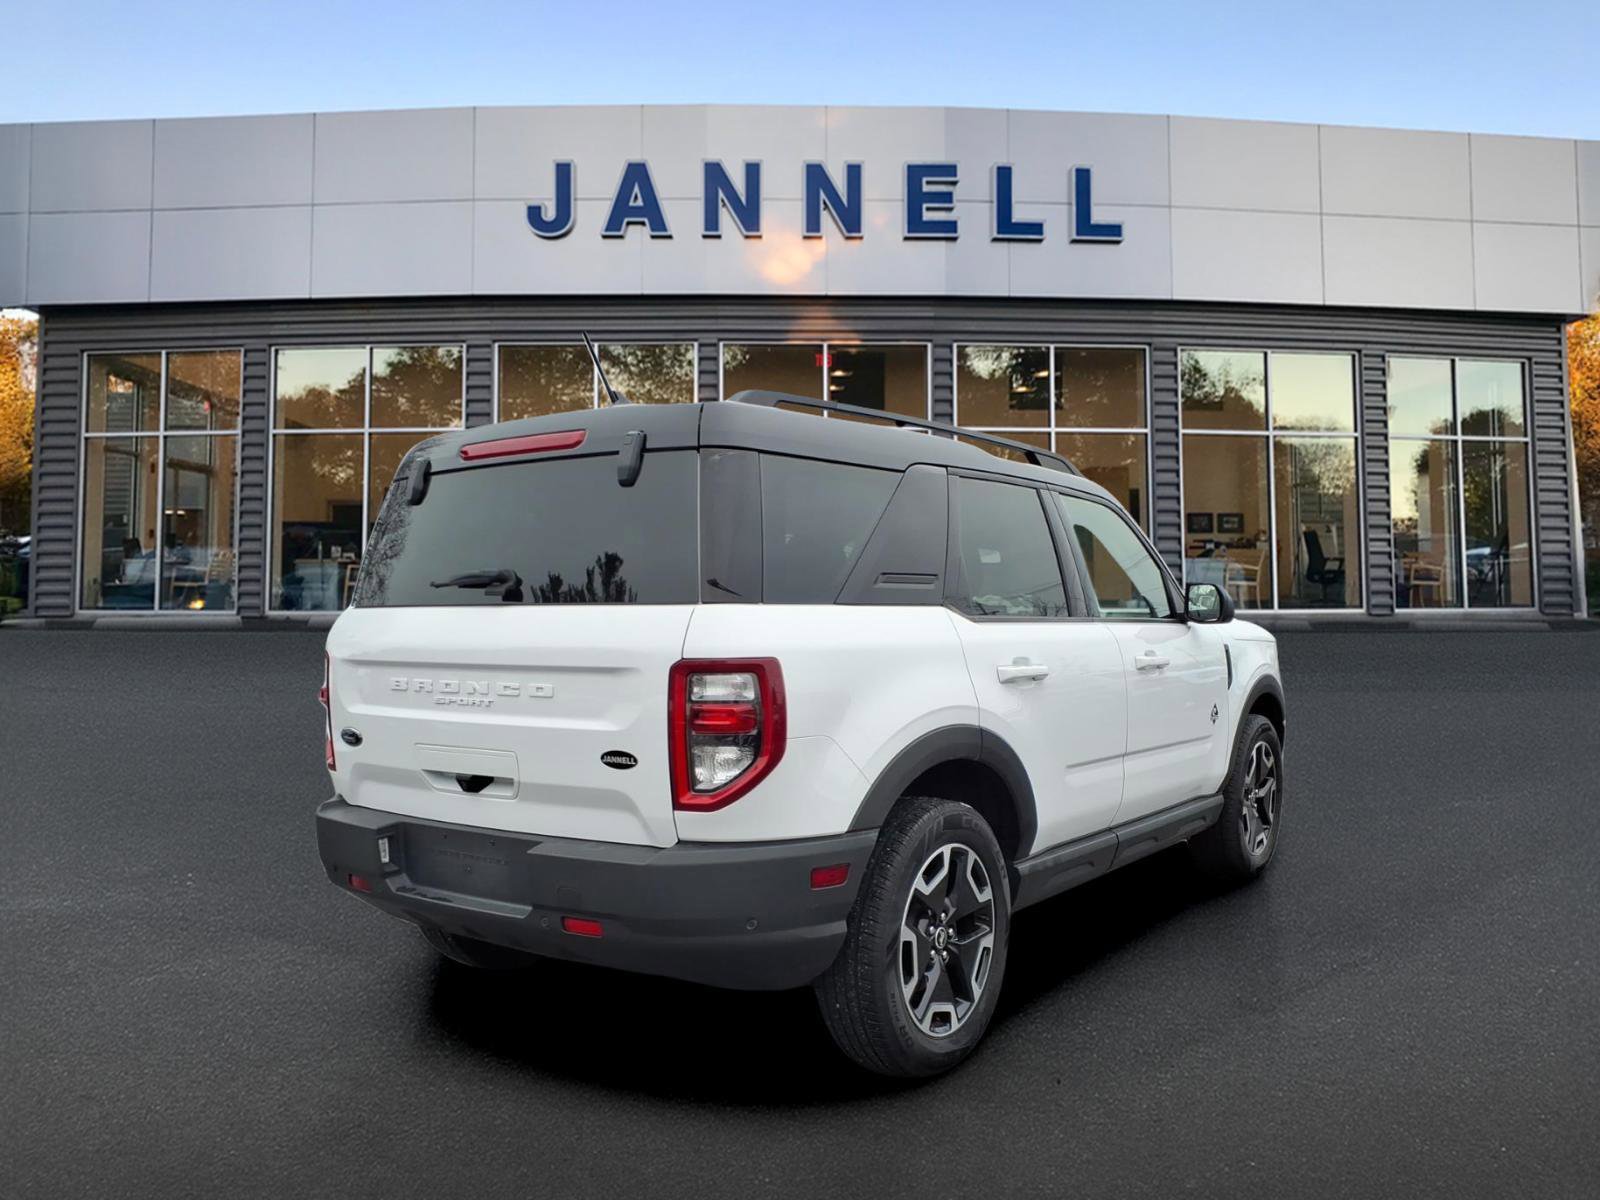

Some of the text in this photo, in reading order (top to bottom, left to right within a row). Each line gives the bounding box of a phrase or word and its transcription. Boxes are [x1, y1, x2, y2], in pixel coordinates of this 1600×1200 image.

[525, 159, 1124, 243] JANNELL
[390, 677, 554, 698] BRONCO
[433, 697, 496, 708] SPORT
[601, 755, 636, 765] JANNELL
